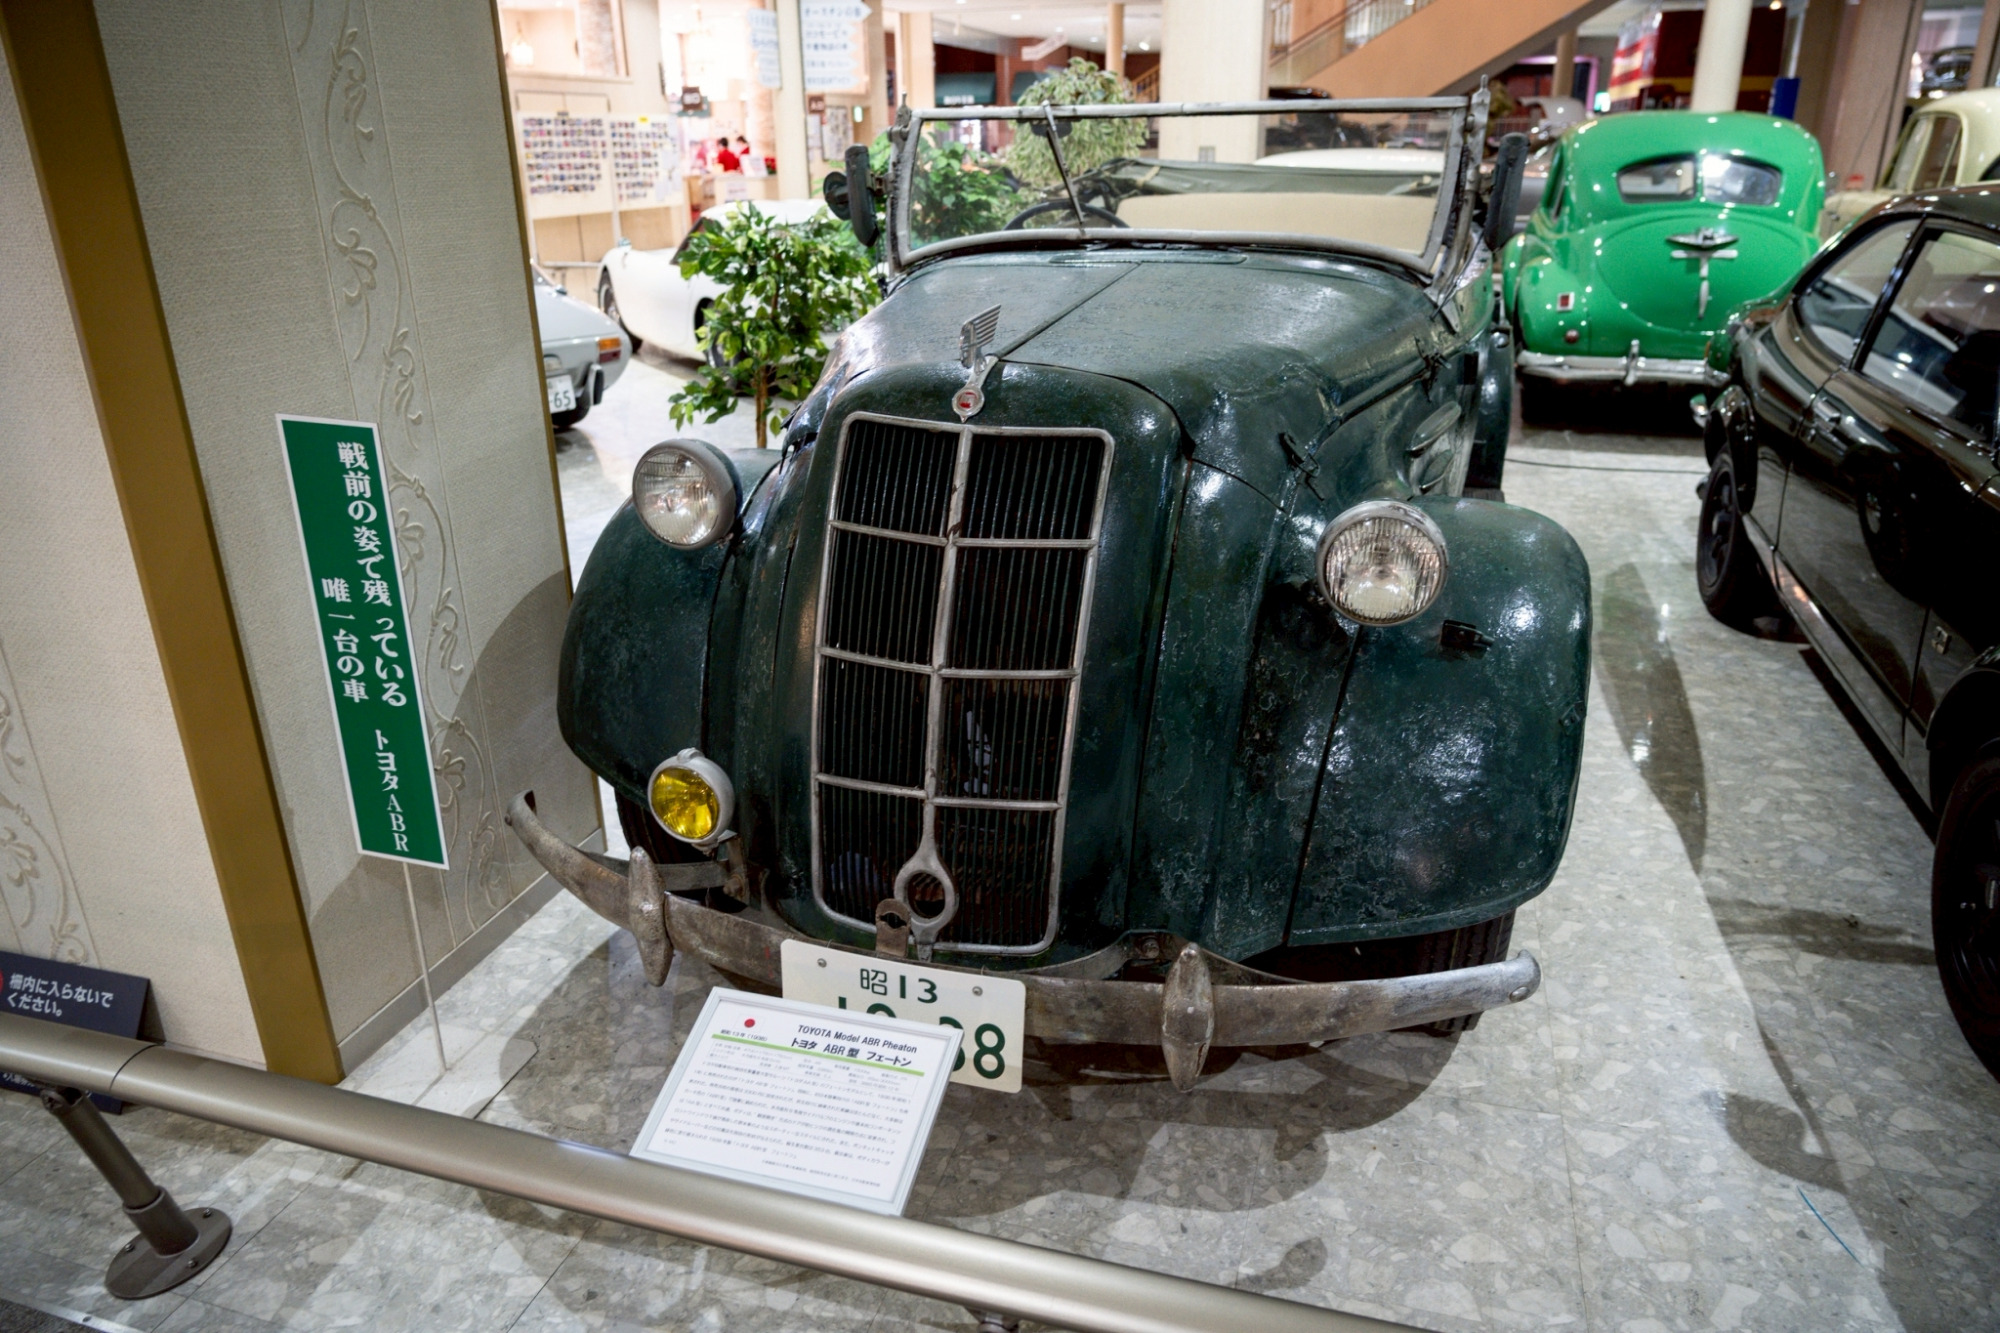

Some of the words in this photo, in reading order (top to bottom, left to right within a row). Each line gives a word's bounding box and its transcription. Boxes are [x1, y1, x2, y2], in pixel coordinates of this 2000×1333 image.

[337, 441, 408, 707] 戦前の姿で残っている
[321, 577, 370, 703] 唯一台の車
[7, 992, 62, 1017] ください。
[9, 973, 114, 1008] 柵内に入らないで
[791, 1037, 818, 1050] トヨタ
[866, 1051, 912, 1067] フェートン
[798, 1025, 831, 1038] TOYOTA
[834, 1032, 860, 1043] Model
[861, 1036, 881, 1047] ABR
[882, 1040, 918, 1054] Pheaton
